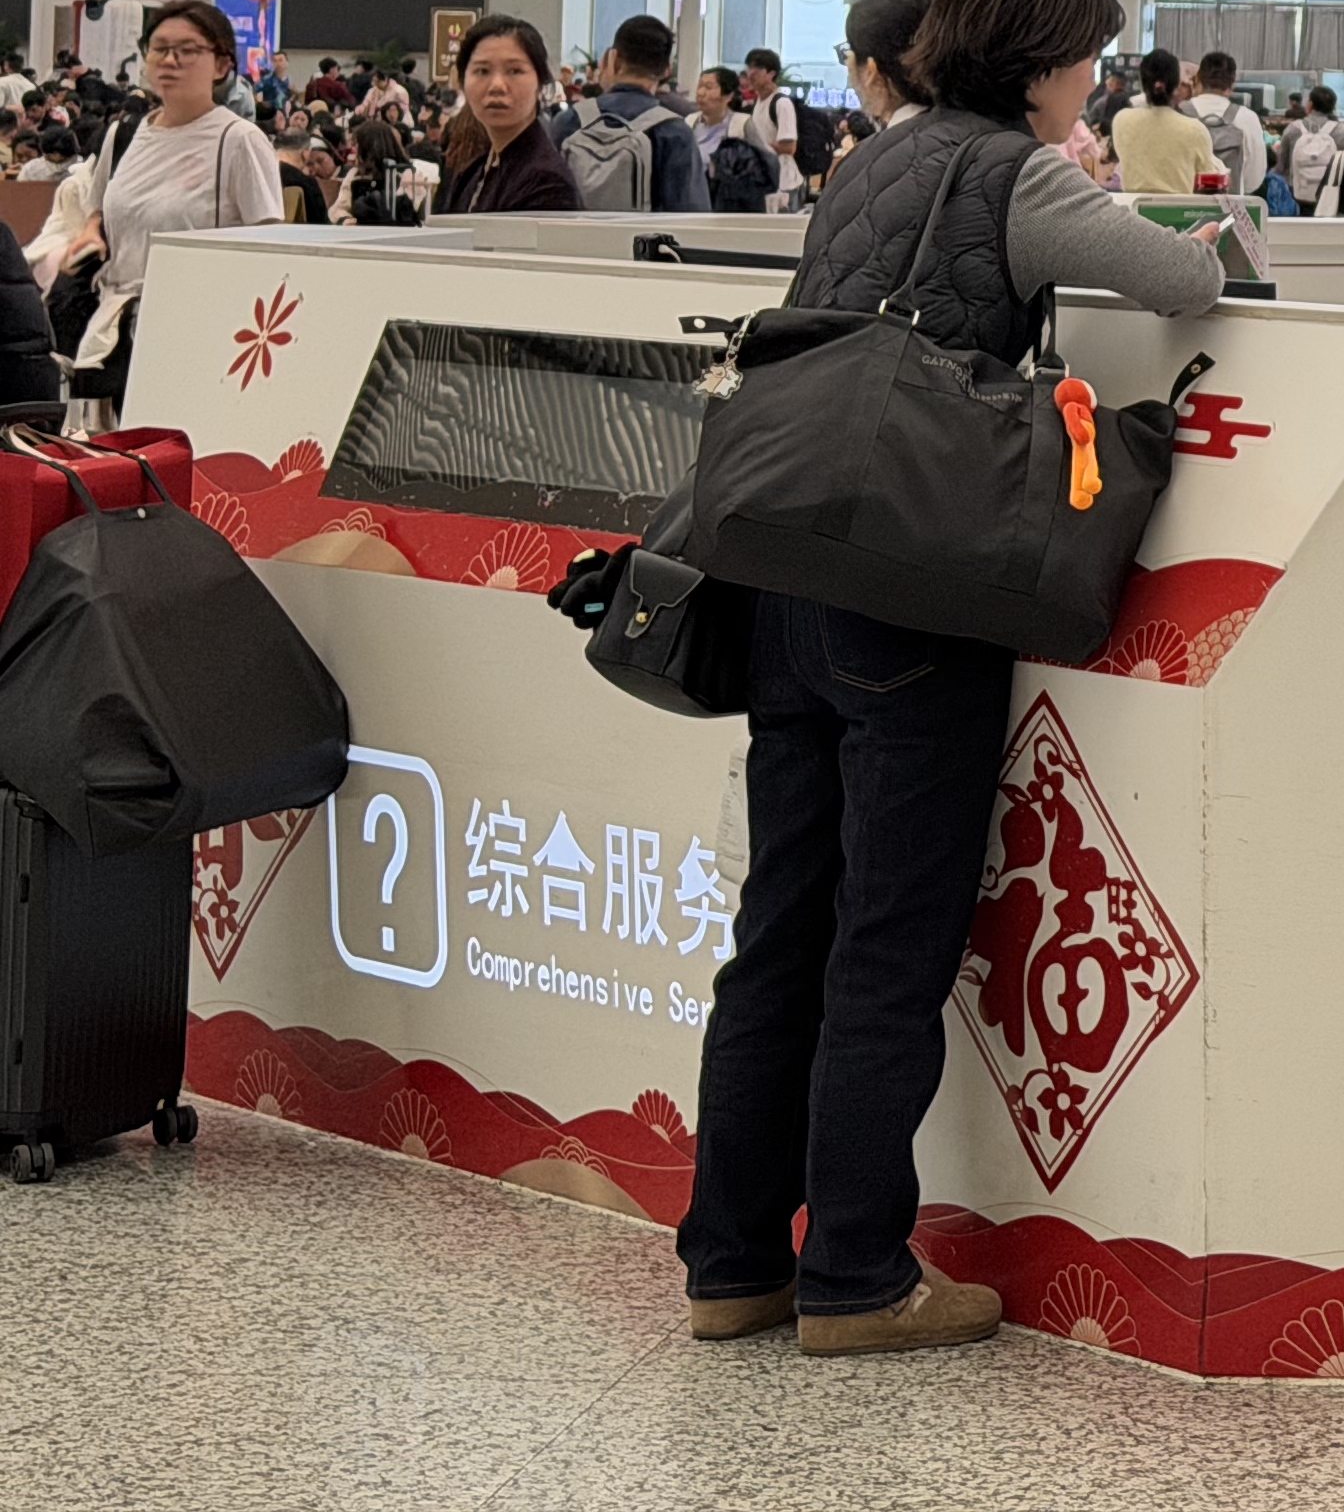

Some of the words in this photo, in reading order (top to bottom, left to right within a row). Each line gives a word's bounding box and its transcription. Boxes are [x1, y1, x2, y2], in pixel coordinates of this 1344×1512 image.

[464, 797, 736, 961] 综合服务
[968, 794, 1132, 1076] 福
[466, 935, 654, 1016] Comprehensive
